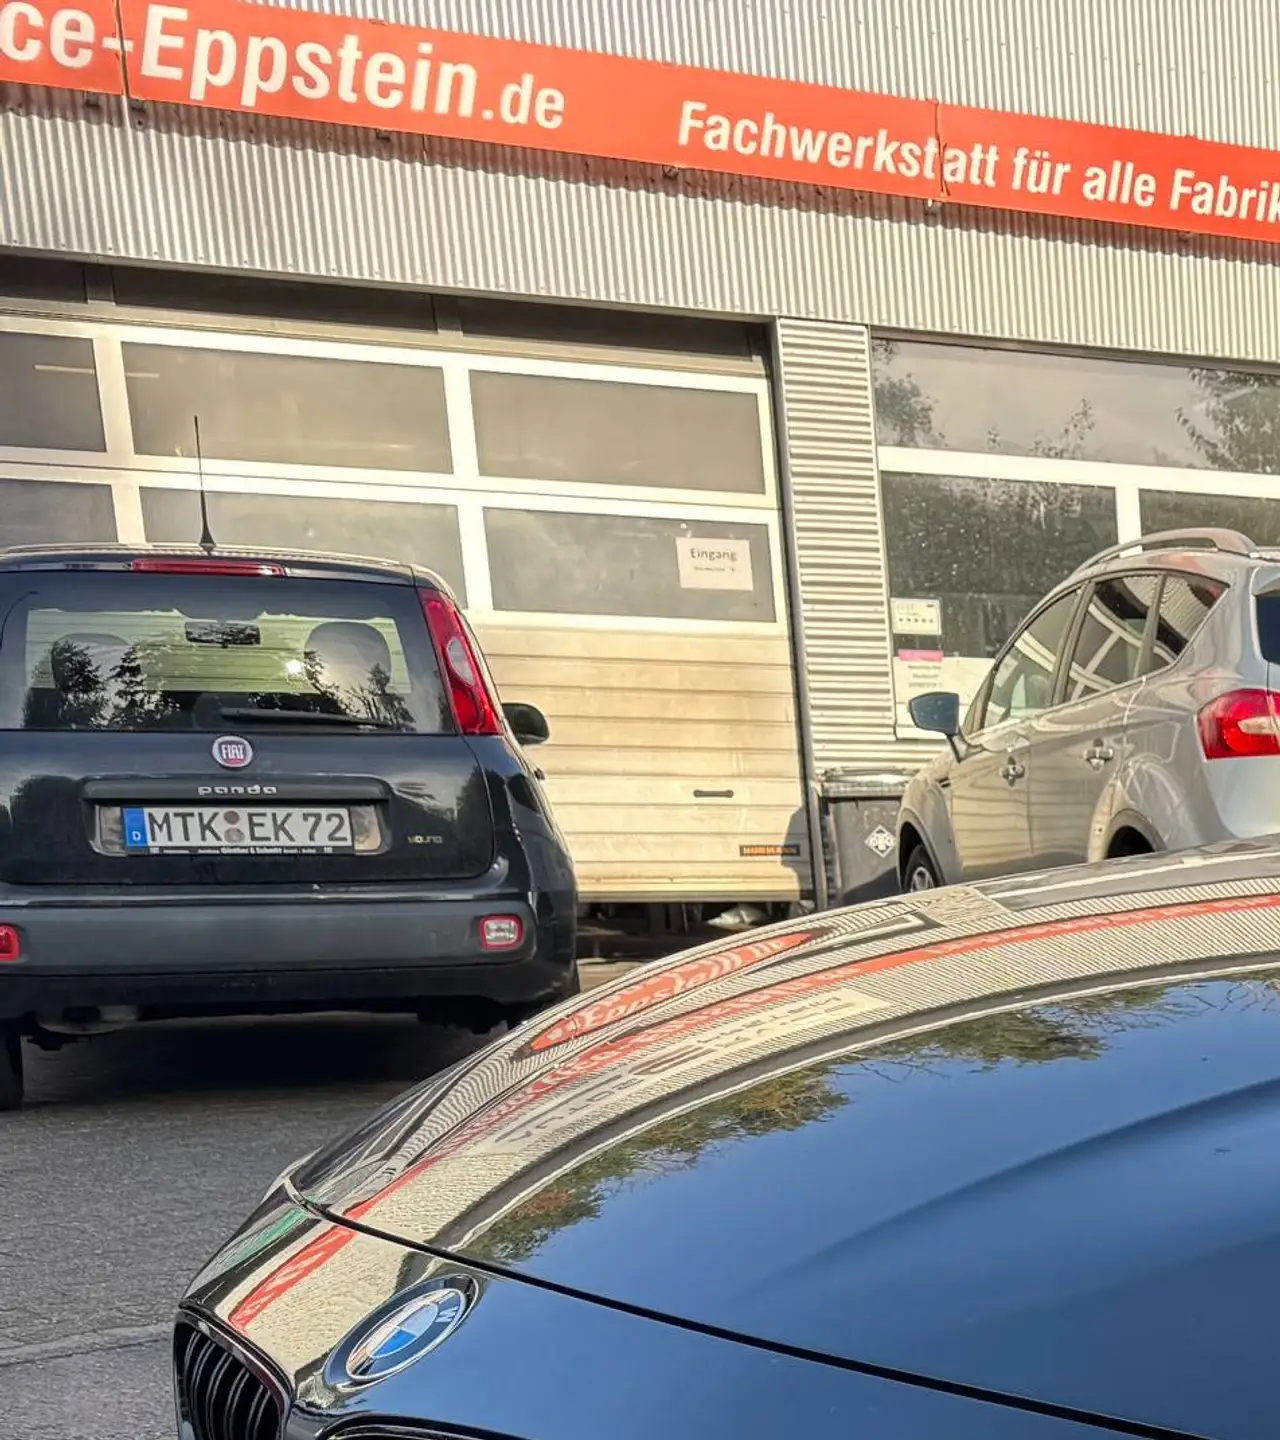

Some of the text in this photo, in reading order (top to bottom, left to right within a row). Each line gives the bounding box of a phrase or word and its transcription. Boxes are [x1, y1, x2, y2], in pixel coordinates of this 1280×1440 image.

[678, 101, 1000, 188] Fachwerkstatt
[1013, 146, 1071, 196] für
[1083, 161, 1157, 208] alle
[689, 547, 739, 562] Eingang
[221, 744, 244, 759] FIAT
[197, 783, 278, 796] panda
[148, 812, 221, 843] MTK
[247, 812, 294, 843] EK
[301, 812, 349, 843] 72
